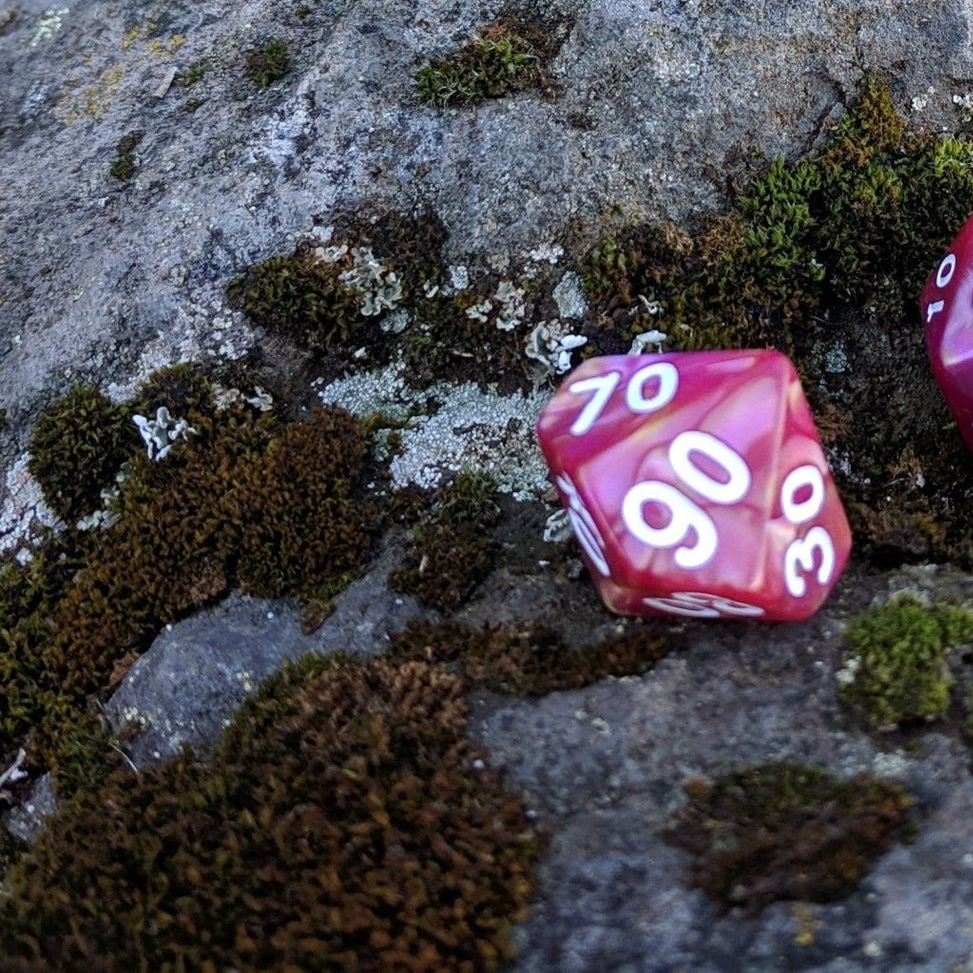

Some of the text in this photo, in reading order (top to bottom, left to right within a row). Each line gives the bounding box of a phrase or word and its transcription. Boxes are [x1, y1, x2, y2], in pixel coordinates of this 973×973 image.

[569, 362, 679, 436] 70
[622, 430, 751, 569] 90
[781, 464, 835, 597] 30
